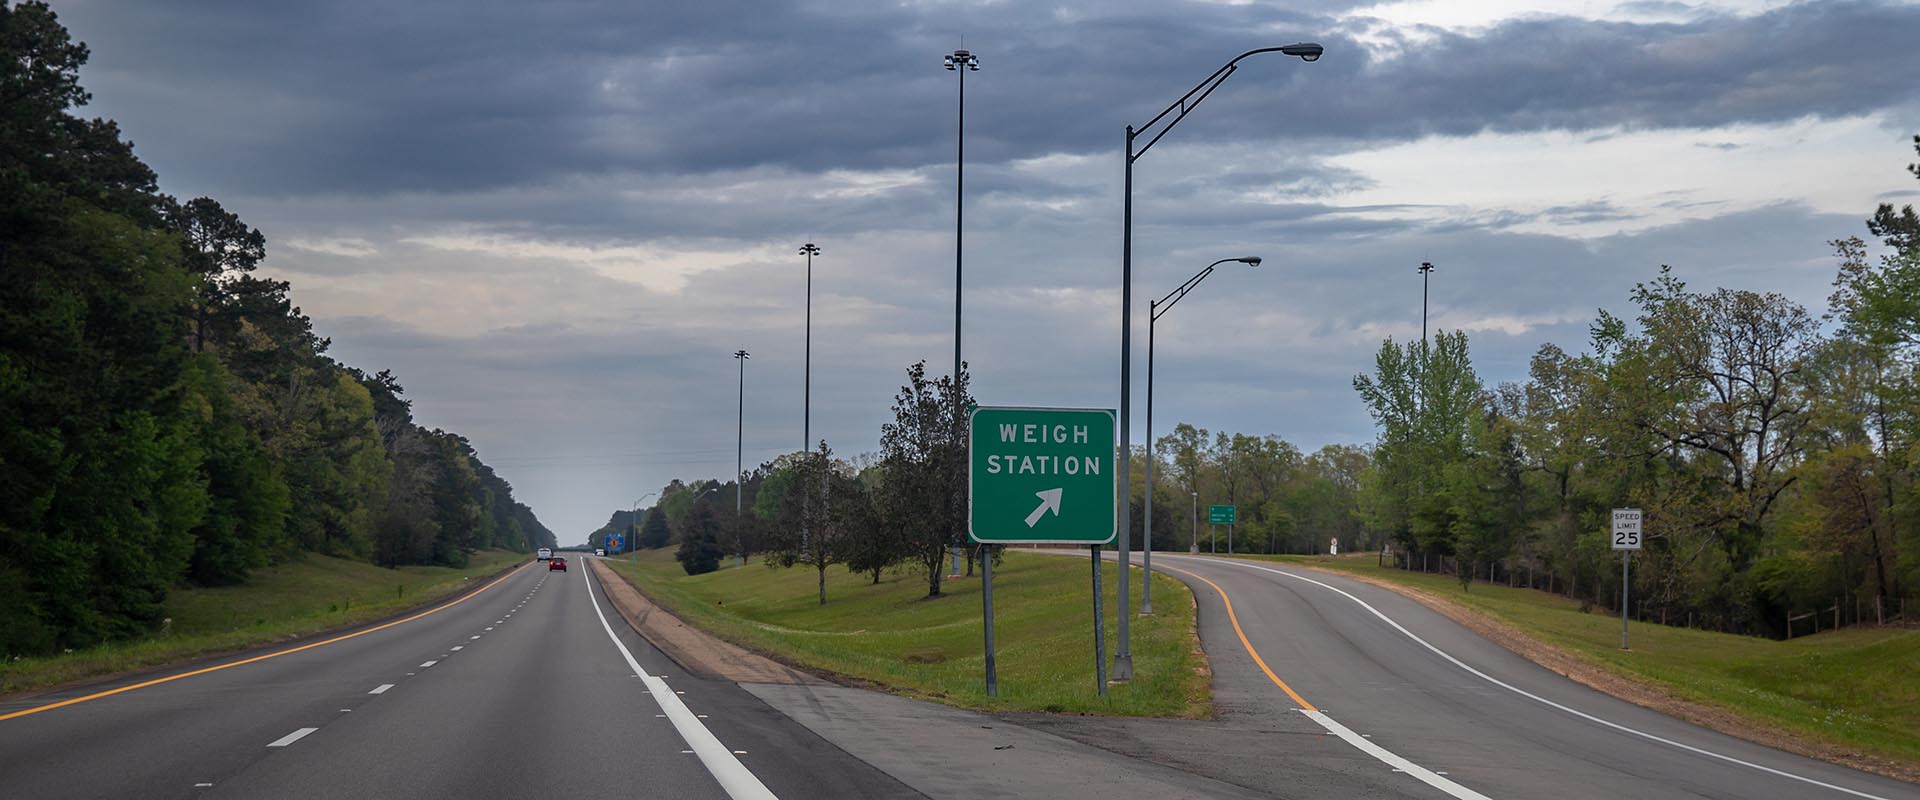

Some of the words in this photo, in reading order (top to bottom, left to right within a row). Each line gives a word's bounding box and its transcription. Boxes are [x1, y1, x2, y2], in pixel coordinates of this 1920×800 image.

[999, 423, 1088, 444] WEIGH
[987, 455, 1100, 475] STATION
[1614, 512, 1640, 520] SPEED
[1615, 531, 1638, 545] 25
